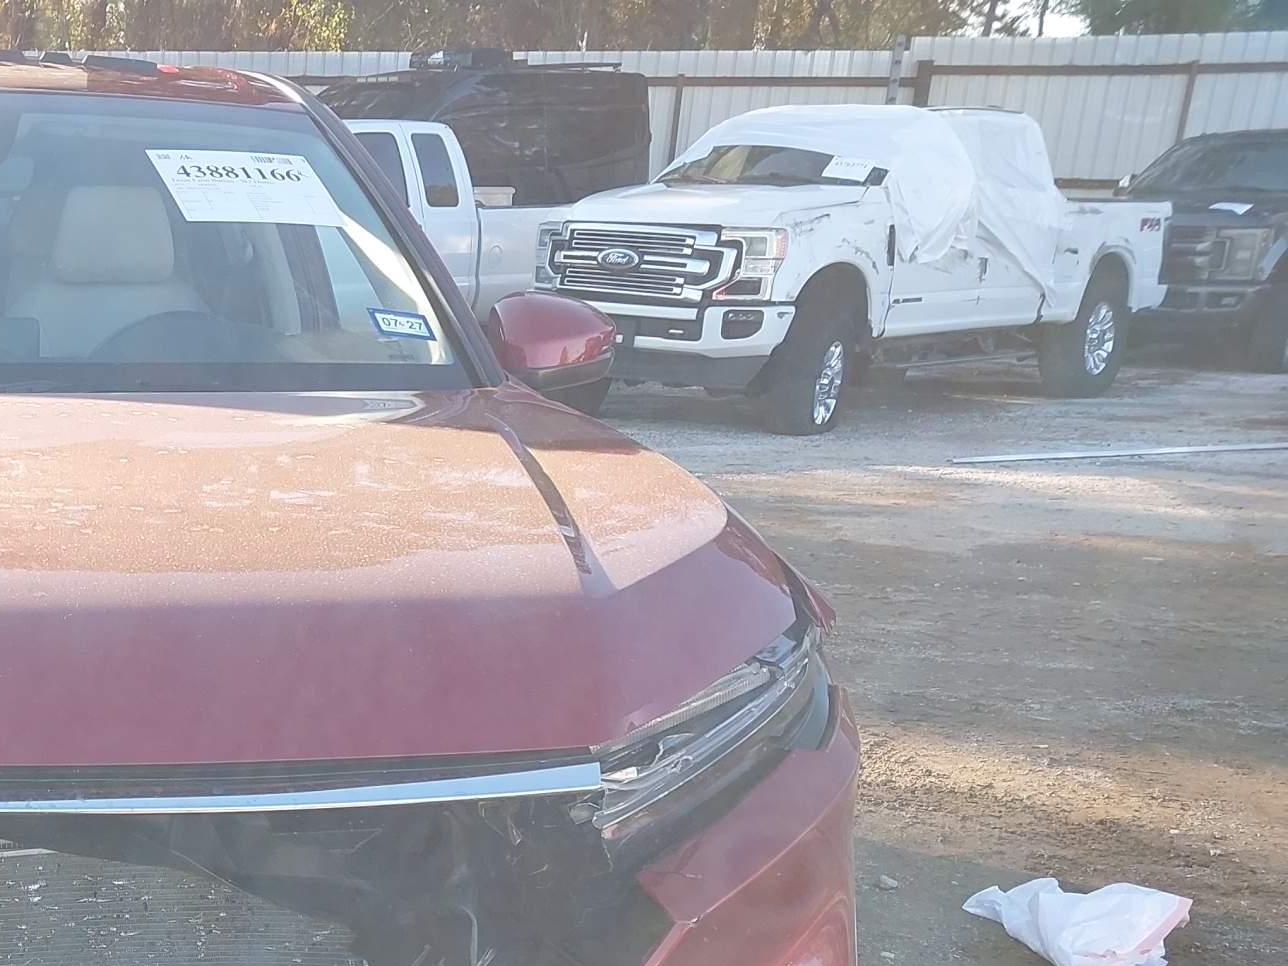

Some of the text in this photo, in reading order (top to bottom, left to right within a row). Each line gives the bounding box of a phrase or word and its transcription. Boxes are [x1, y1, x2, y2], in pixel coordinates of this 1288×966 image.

[176, 165, 301, 182] 43881166
[381, 317, 398, 328] 07
[406, 320, 423, 331] 27
